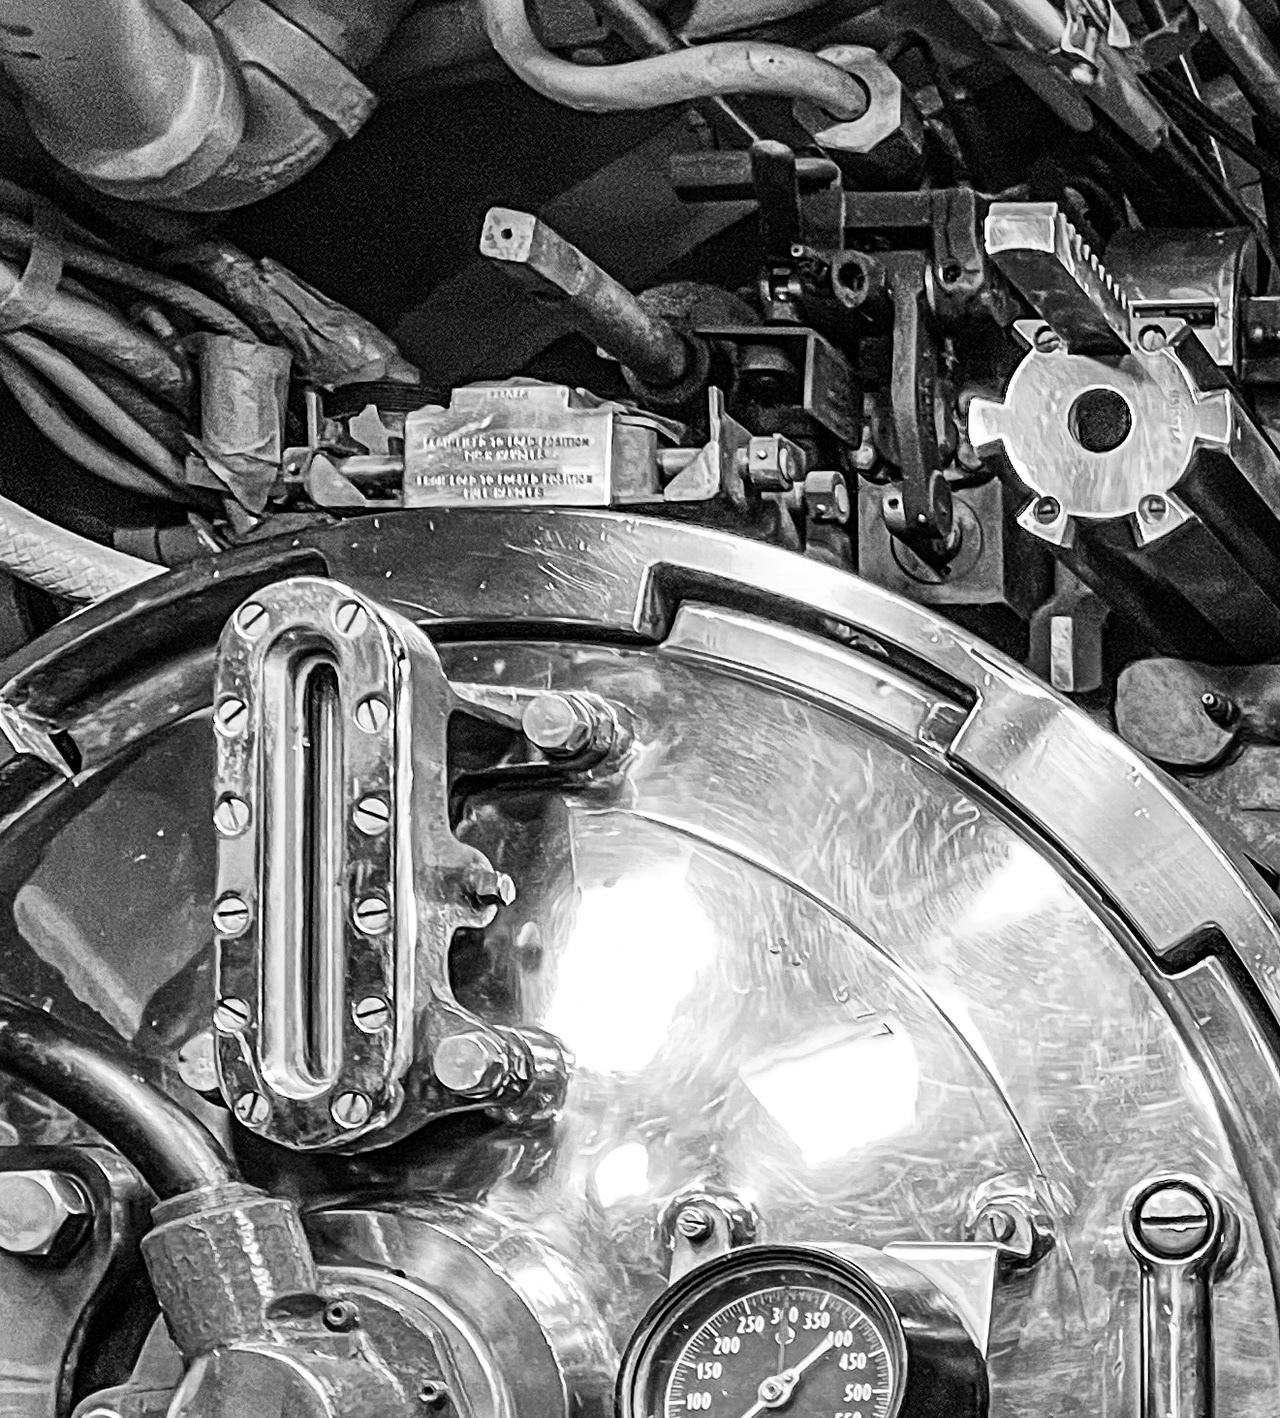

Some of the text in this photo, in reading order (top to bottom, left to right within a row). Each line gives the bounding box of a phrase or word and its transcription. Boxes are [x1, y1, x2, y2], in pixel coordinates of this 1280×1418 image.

[737, 1316, 764, 1333] 250
[803, 1312, 830, 1329] 350
[713, 1337, 740, 1355] 200
[839, 1352, 866, 1370] 450
[697, 1362, 722, 1379] 150
[686, 1392, 712, 1410] 100
[843, 1384, 871, 1402] 500
